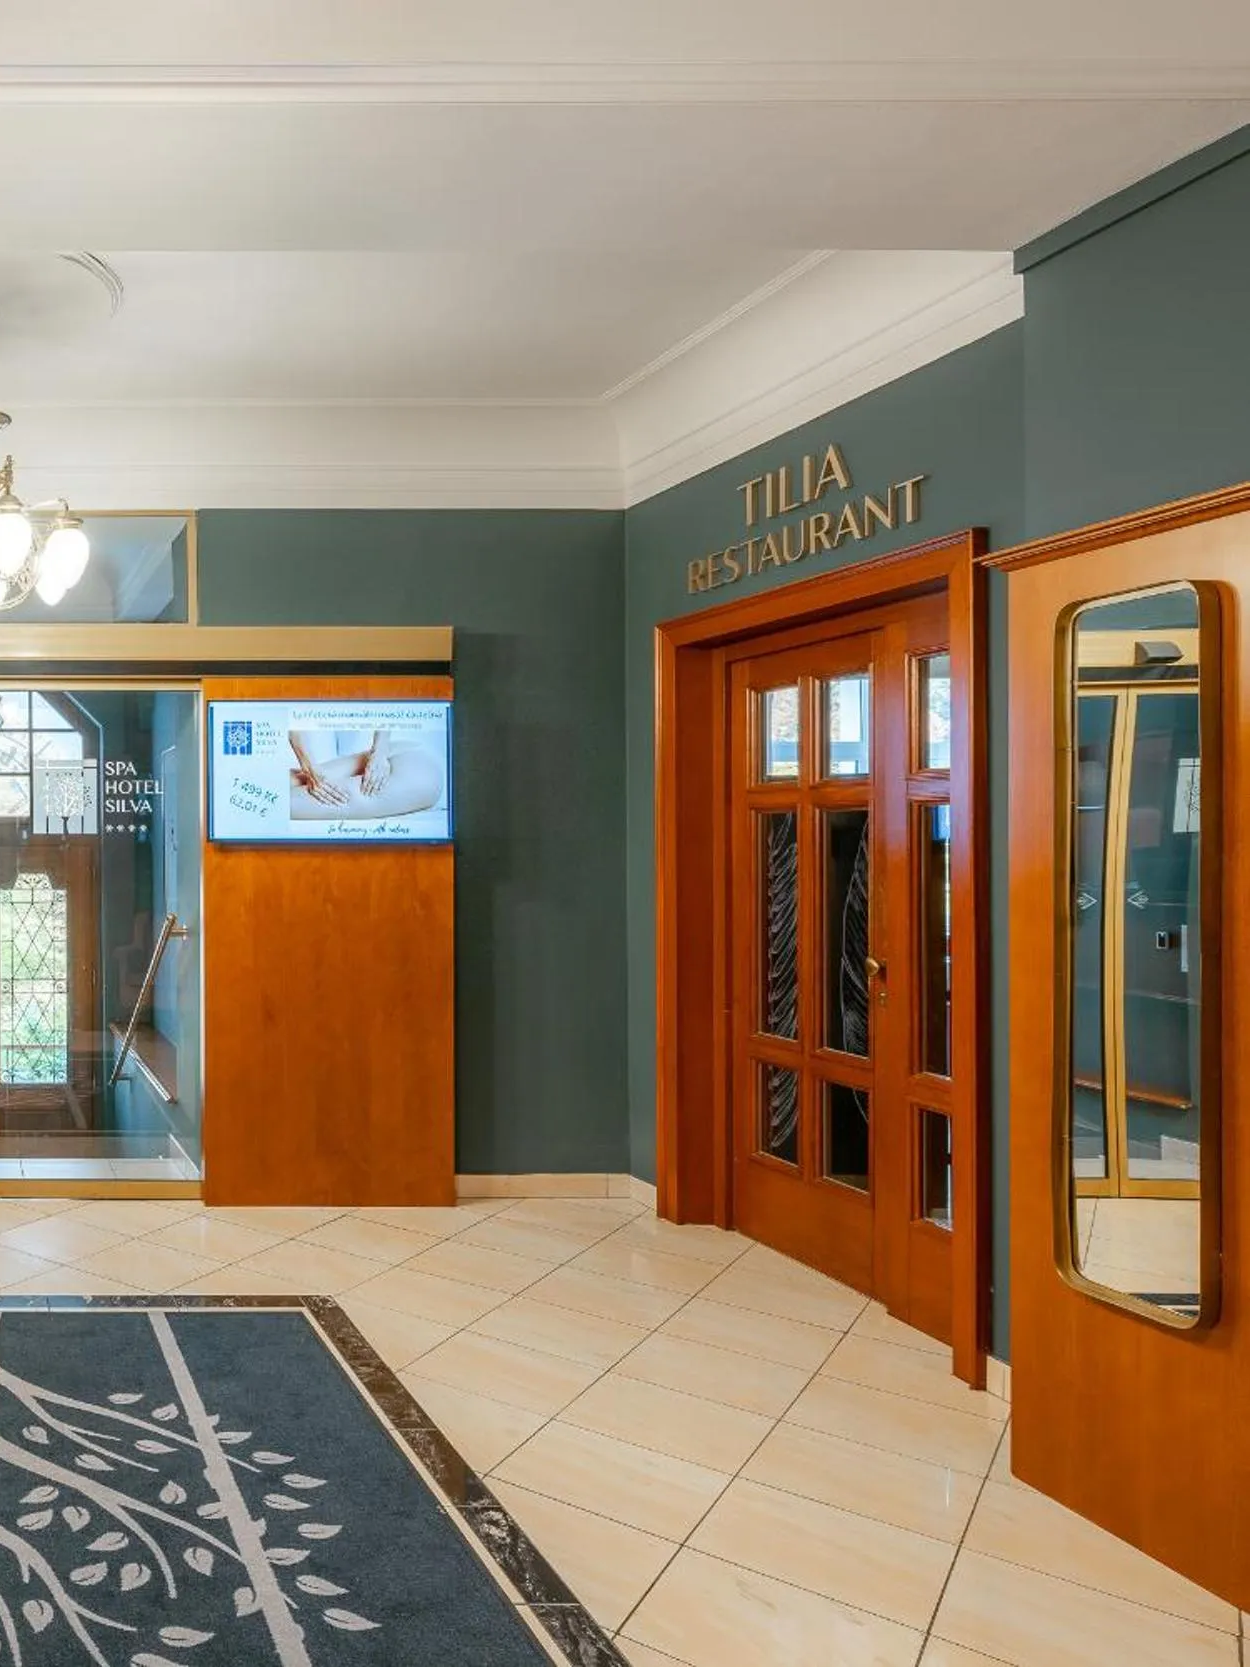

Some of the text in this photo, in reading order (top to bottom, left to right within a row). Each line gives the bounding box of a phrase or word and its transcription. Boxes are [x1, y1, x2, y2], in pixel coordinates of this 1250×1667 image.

[736, 443, 851, 526] TILIA
[687, 474, 927, 594] RESTAURANT
[105, 761, 137, 776] SPA
[105, 780, 164, 795] HOTEL
[105, 798, 153, 813] SILVA
